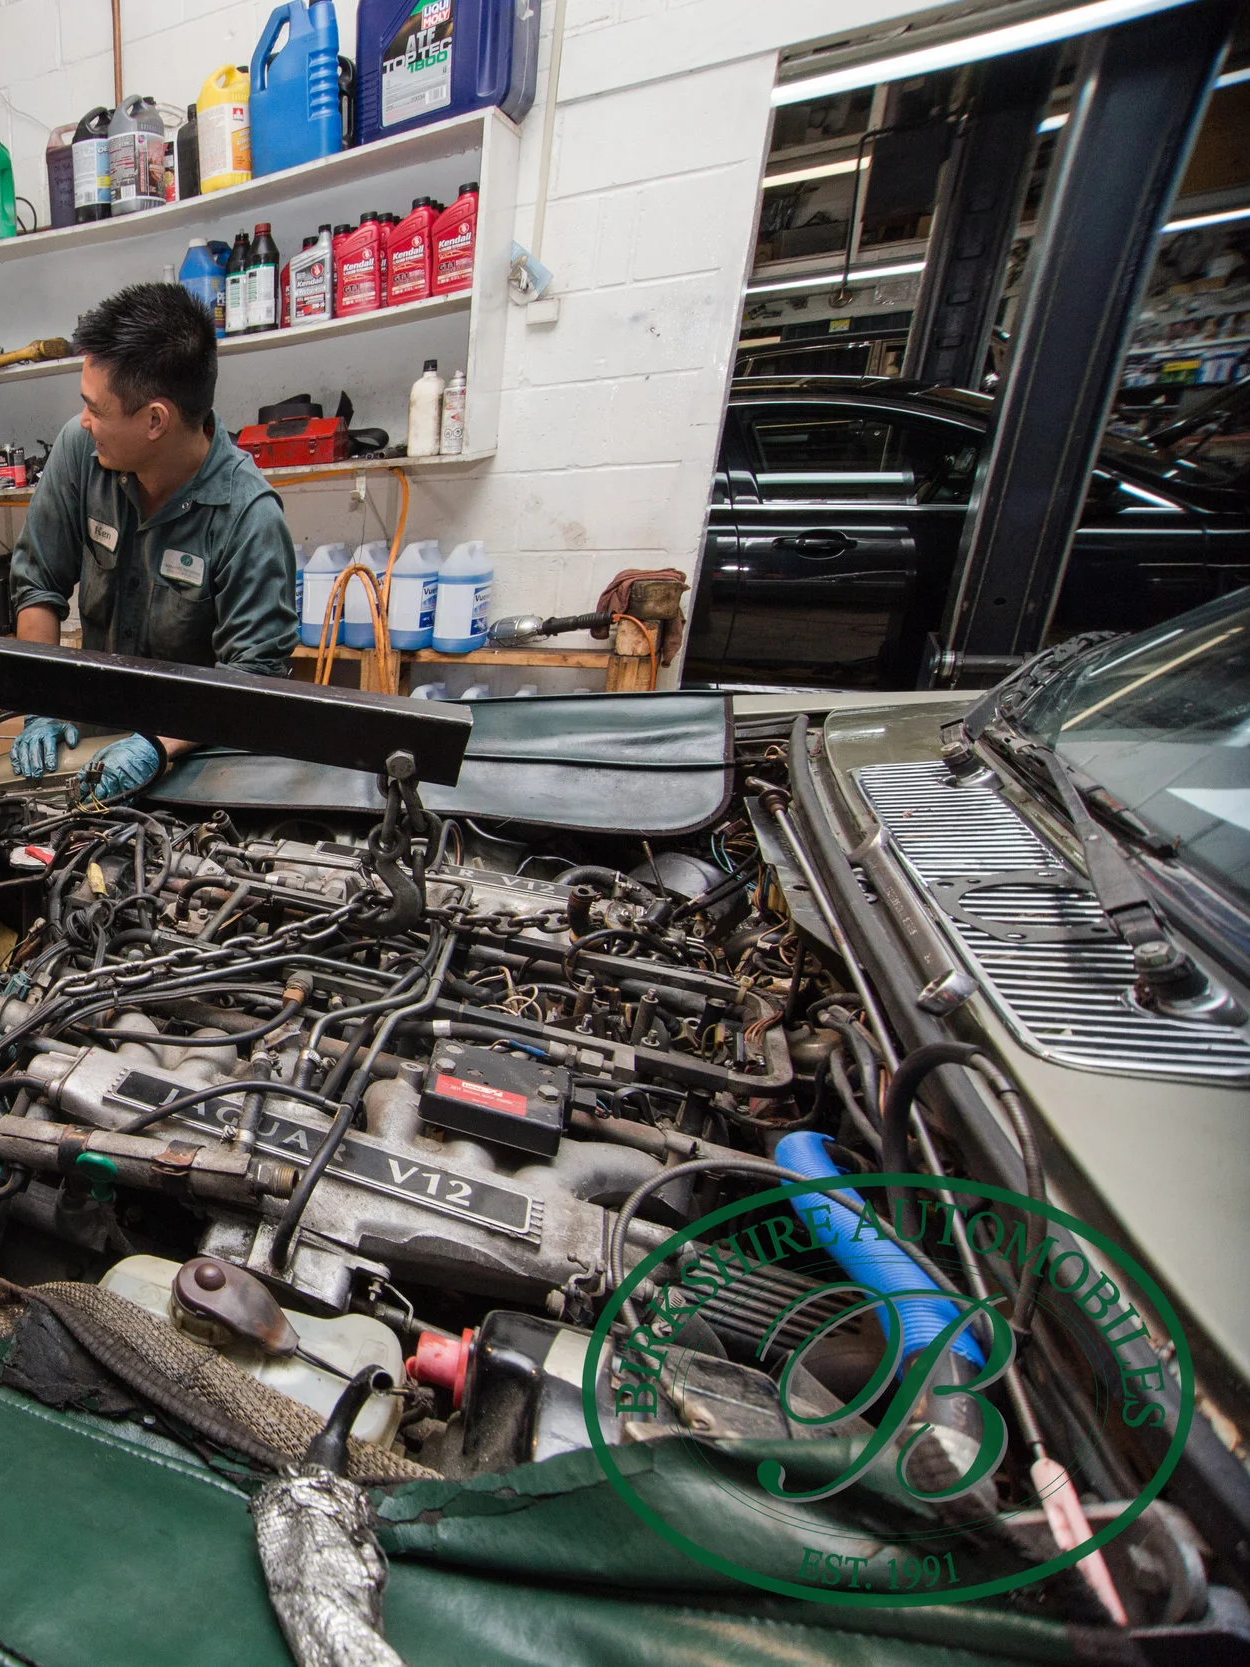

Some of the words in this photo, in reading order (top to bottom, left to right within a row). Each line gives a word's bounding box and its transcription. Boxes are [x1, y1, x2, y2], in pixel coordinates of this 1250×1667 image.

[422, 9, 450, 29] MOLY
[405, 26, 436, 54] ATF
[382, 50, 417, 75] TOP
[418, 37, 452, 61] TEC
[407, 50, 448, 73] 1800
[439, 231, 472, 249] Kendall
[393, 244, 425, 261] Kendall
[343, 257, 375, 271] Kendall
[297, 276, 324, 288] Kendall
[94, 525, 112, 541] Ken
[501, 876, 556, 895] V12
[388, 1158, 473, 1207] V12
